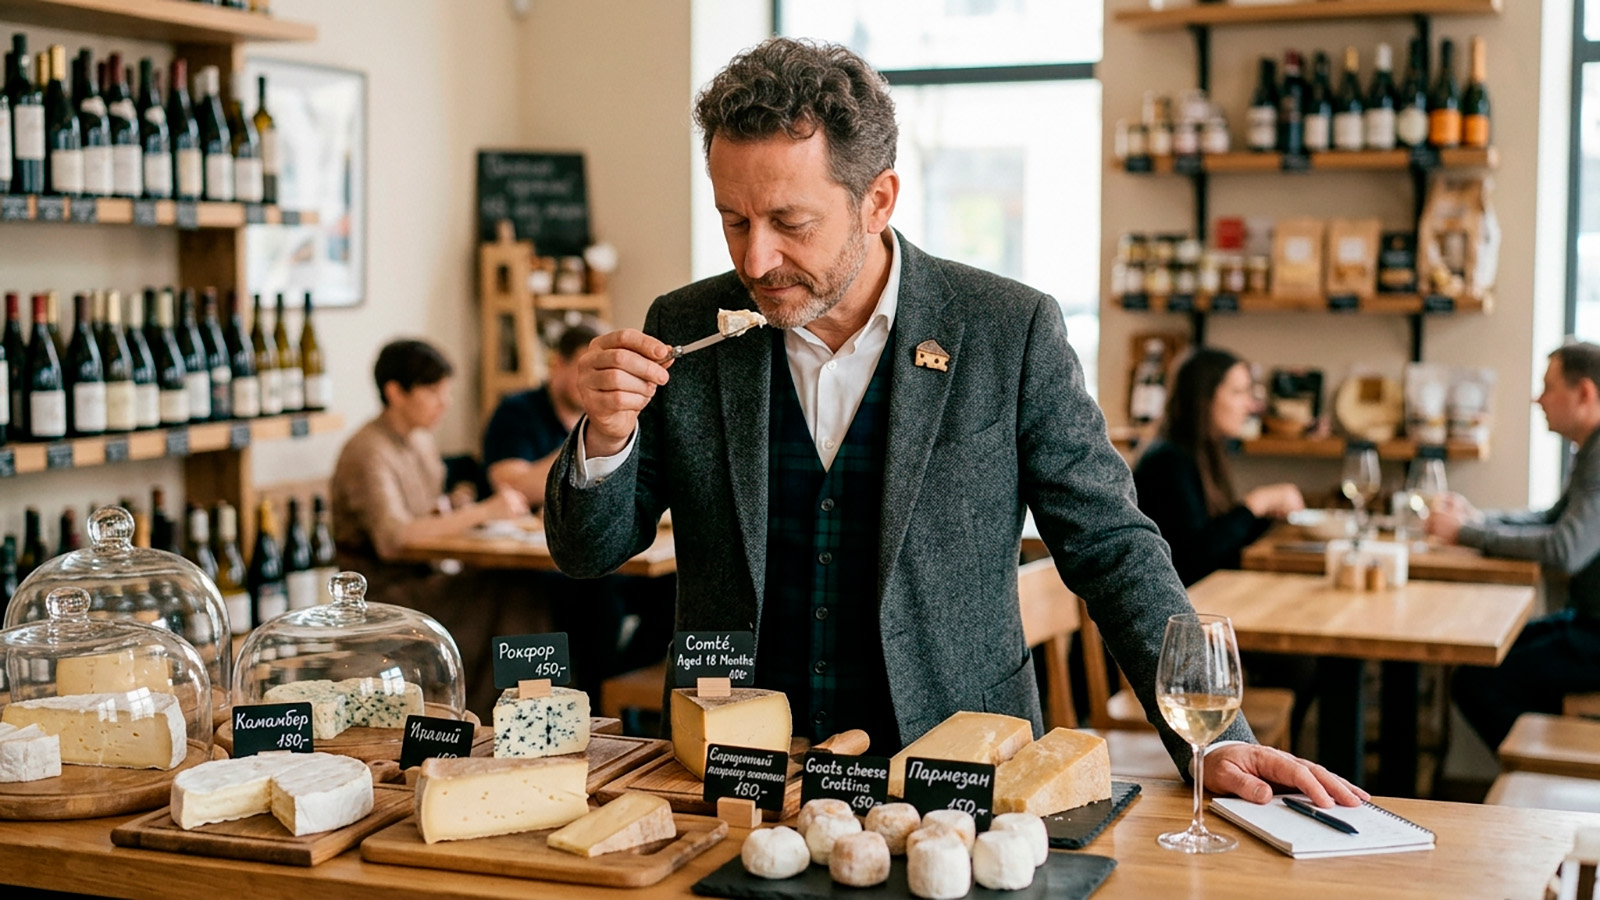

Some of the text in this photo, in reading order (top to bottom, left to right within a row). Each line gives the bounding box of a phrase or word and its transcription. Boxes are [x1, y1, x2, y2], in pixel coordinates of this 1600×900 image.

[498, 642, 555, 663] Рокфор
[685, 634, 735, 653] Comté,
[535, 662, 567, 678] 450,-
[676, 653, 702, 670] Aged
[706, 654, 717, 666] 18
[235, 709, 309, 731] Камамбер
[805, 757, 843, 776] Goats
[846, 762, 888, 780] cheese
[908, 761, 990, 790] Пармезан
